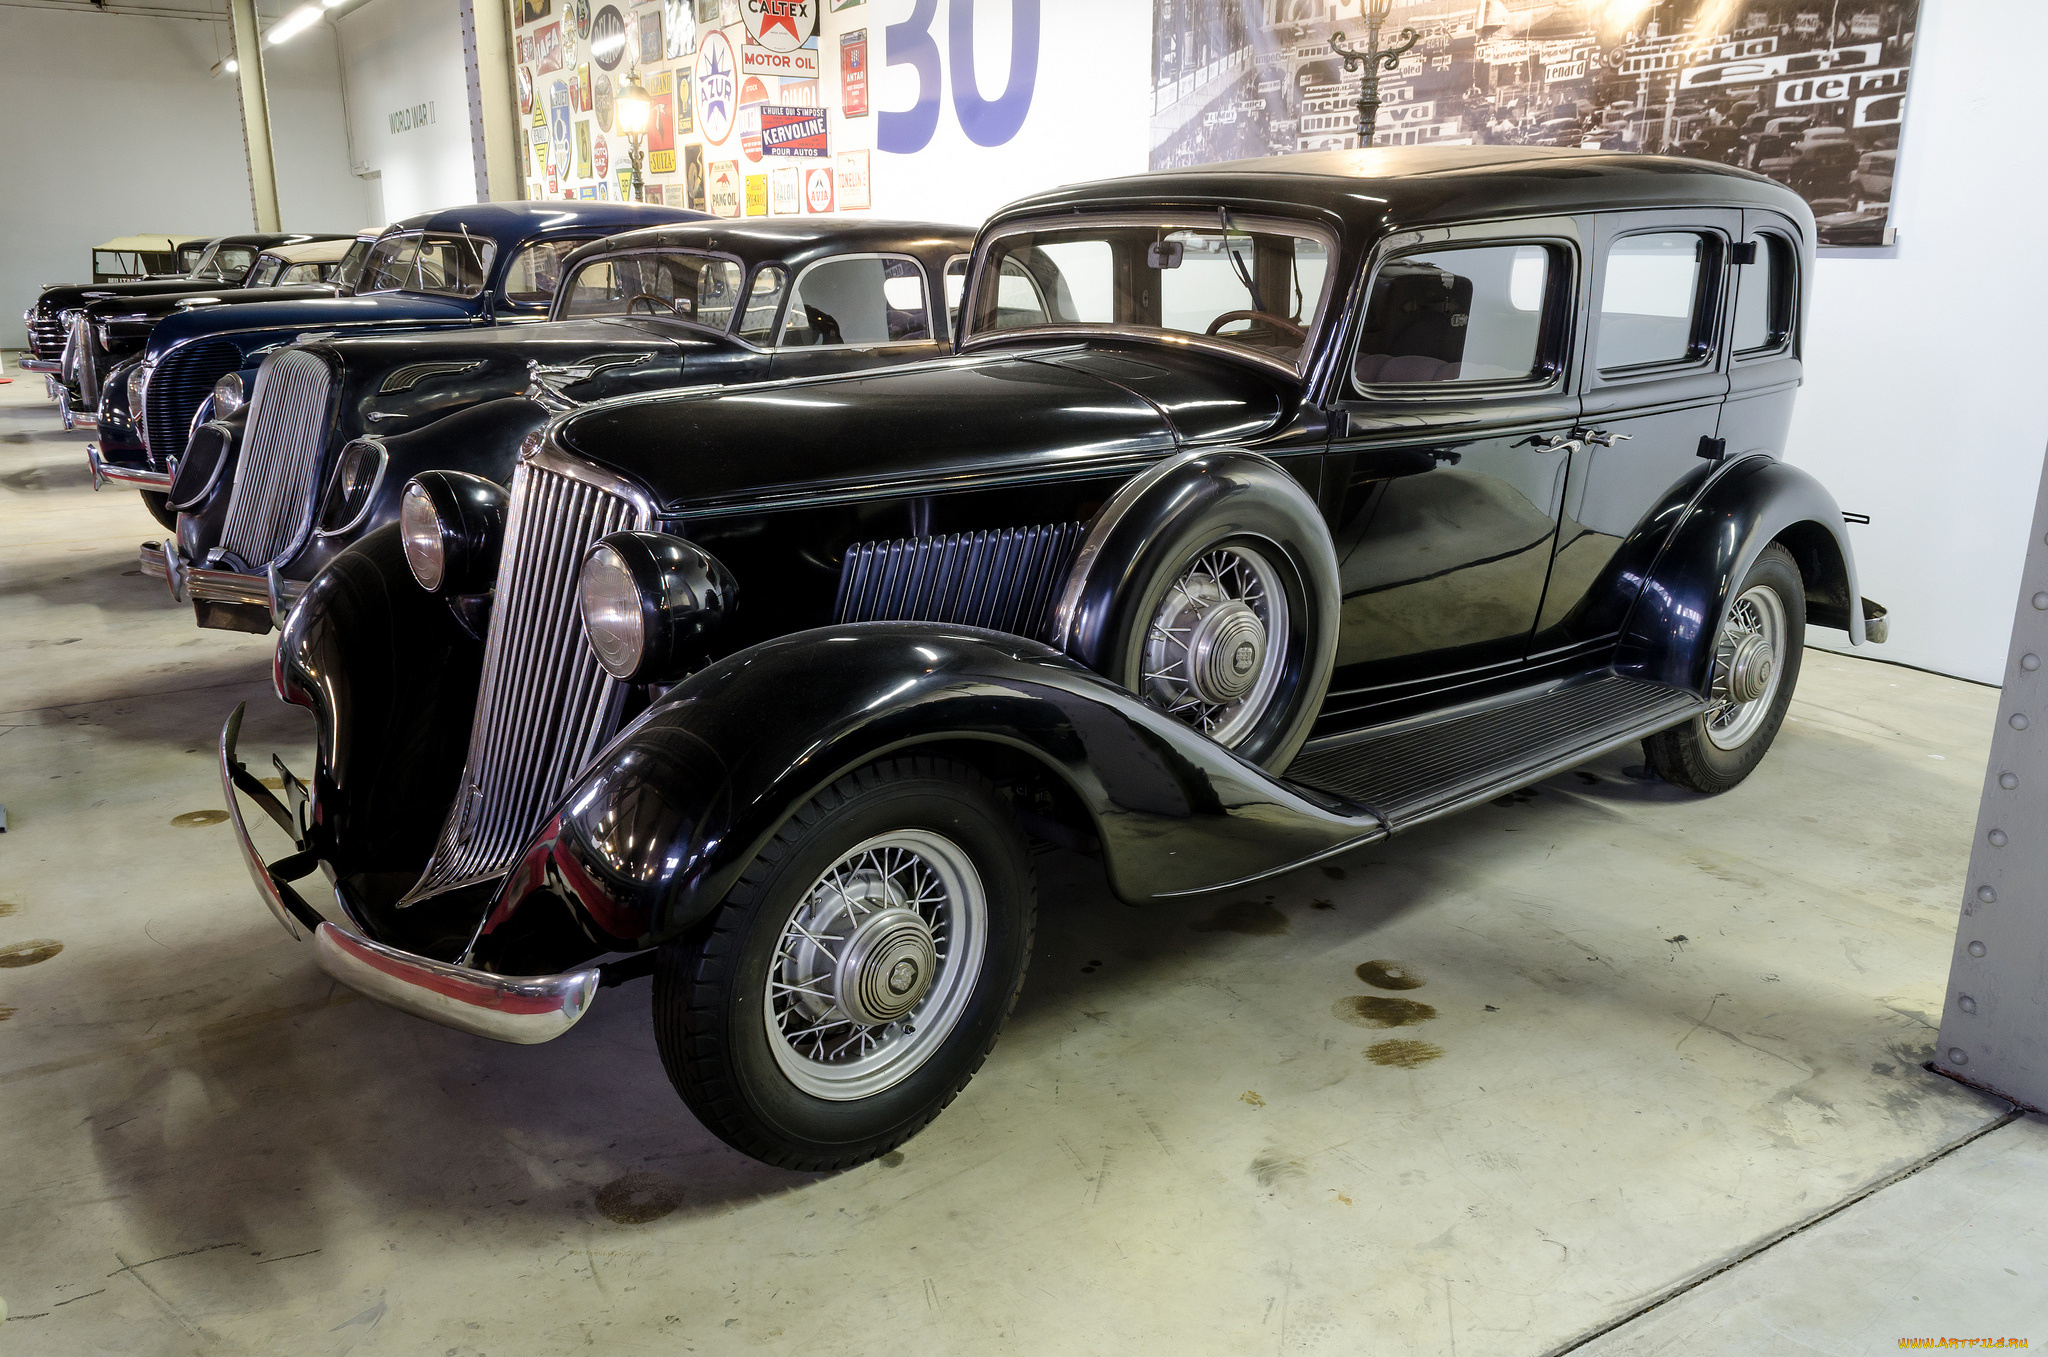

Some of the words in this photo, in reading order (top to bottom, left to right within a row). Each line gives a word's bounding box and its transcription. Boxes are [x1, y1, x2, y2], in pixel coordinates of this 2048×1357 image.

[748, 0, 808, 18] CALTEX
[744, 52, 790, 67] MOTOR
[795, 57, 816, 70] OIL
[1546, 61, 1584, 79] renard
[847, 70, 864, 83] ANTAR
[877, 0, 1040, 154] 30
[701, 78, 732, 107] AZUR
[745, 84, 758, 93] STOCK
[1303, 88, 1413, 112] peuot
[388, 108, 411, 134] WORLD
[411, 103, 428, 128] WAR
[429, 100, 436, 124] II
[762, 107, 784, 115] L'HUILE
[785, 107, 795, 116] QUI
[796, 108, 824, 117] S'IMPOSE
[1303, 105, 1429, 130] minva
[762, 118, 826, 146] KERVOLINE
[652, 152, 673, 170] SUIZA
[811, 190, 829, 201] AVIA
